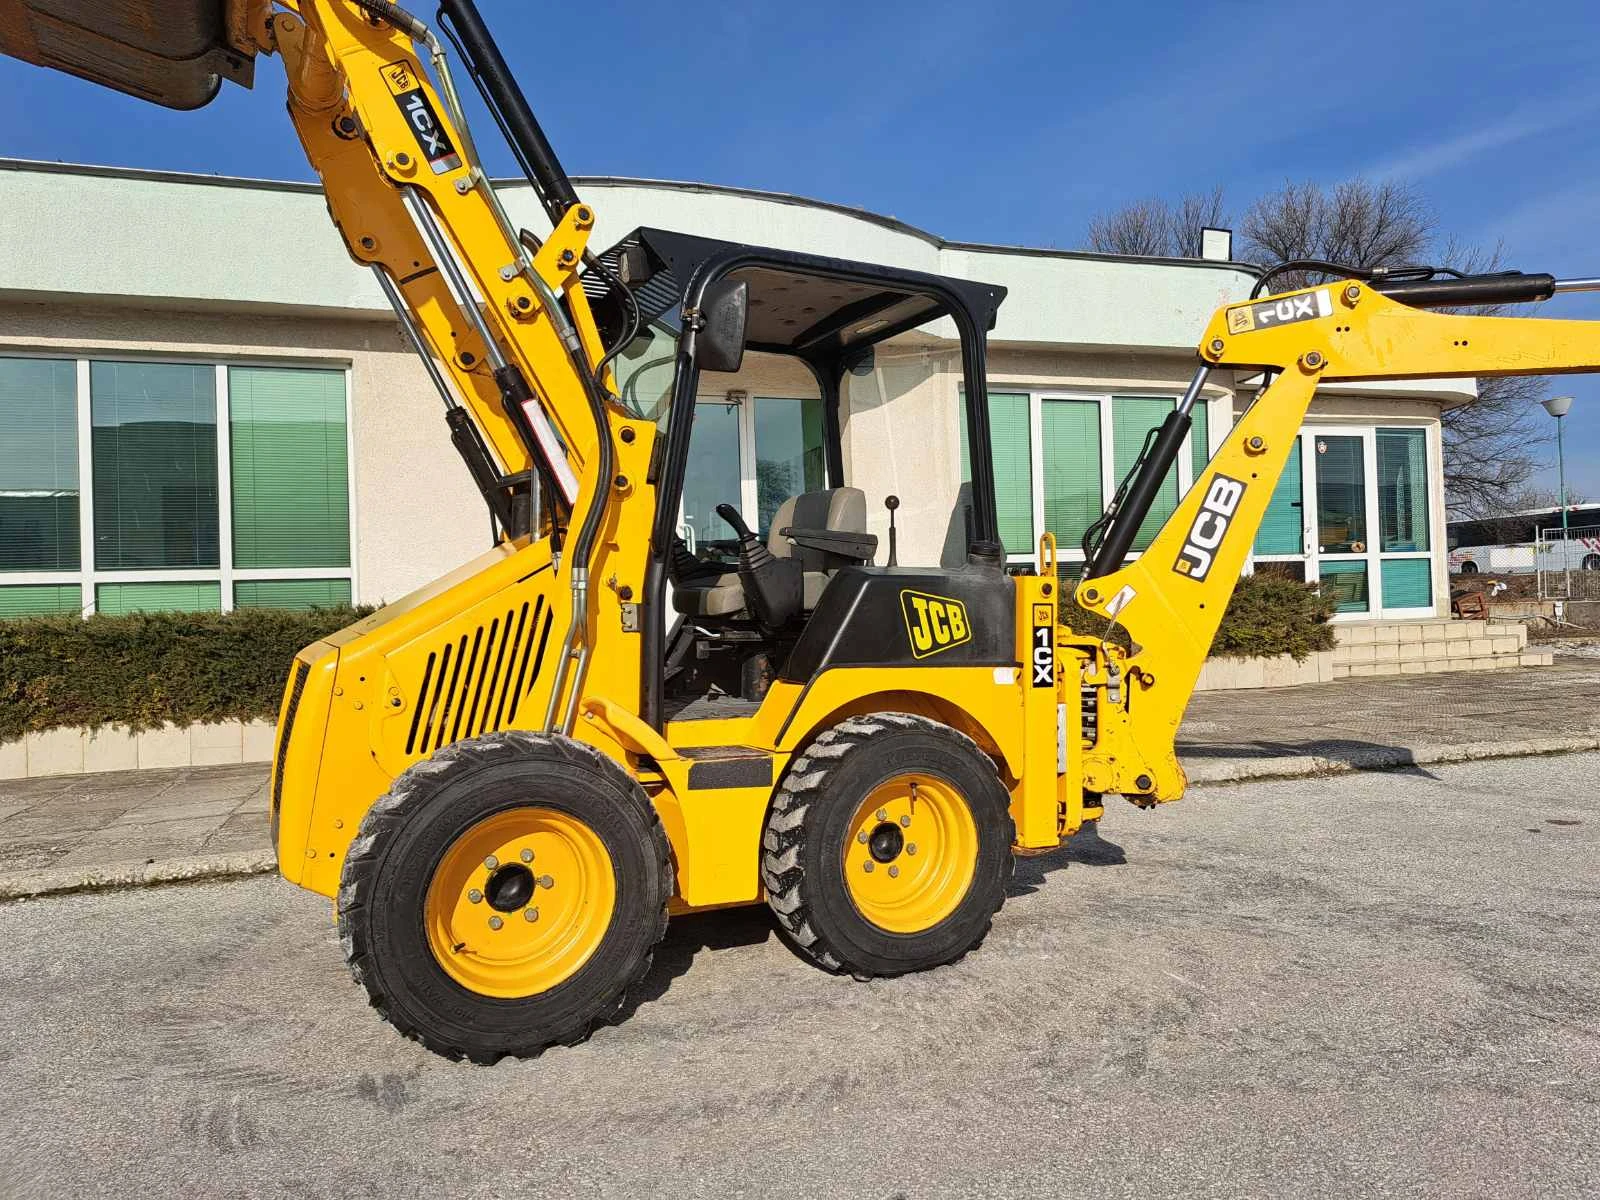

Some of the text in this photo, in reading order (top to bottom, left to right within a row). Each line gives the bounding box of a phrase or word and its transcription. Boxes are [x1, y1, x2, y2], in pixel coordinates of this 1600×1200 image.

[391, 67, 409, 89] JCB
[406, 95, 447, 156] 1CX
[1258, 295, 1314, 324] 1CX
[1183, 478, 1243, 578] JCB
[911, 596, 966, 651] JCB
[1033, 628, 1053, 683] 1CX
